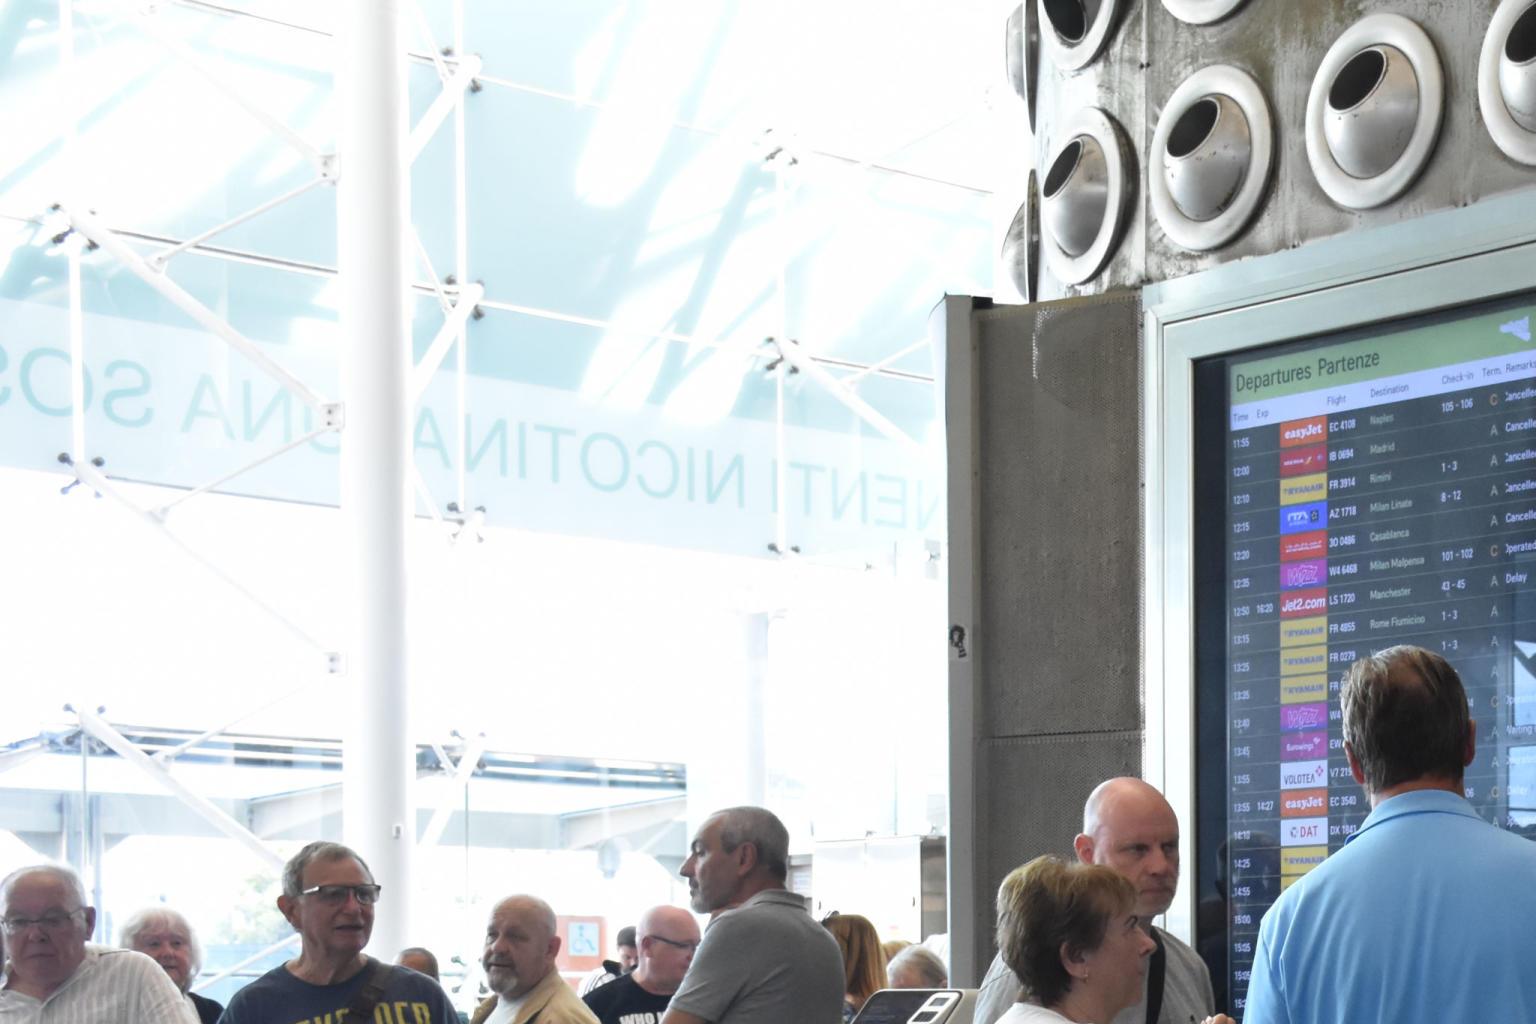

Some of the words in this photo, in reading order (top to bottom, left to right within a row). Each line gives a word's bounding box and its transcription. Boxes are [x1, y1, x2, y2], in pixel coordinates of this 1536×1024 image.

[1236, 365, 1312, 392] Departures
[1318, 352, 1380, 376] Partenze
[1233, 413, 1248, 422] Time
[1327, 395, 1346, 406] Flight
[1370, 383, 1409, 398] Destination
[1442, 372, 1474, 385] Check-in
[1233, 438, 1250, 448] 11:55
[1284, 424, 1323, 440] easyJet
[1370, 442, 1396, 454] Madrid
[1490, 424, 1498, 436] A
[1233, 494, 1250, 505] 12:10
[1329, 480, 1338, 490] FR
[1370, 472, 1392, 483] Rimini
[1233, 522, 1250, 533] 12:15
[1329, 508, 1340, 520] AZ
[1370, 528, 1410, 542] Casablanca
[1442, 552, 1454, 562] 101
[1461, 548, 1474, 560] 102
[1282, 598, 1326, 612] Jet2.com
[1370, 586, 1412, 600] Manchester
[1506, 572, 1528, 584] Delay
[1370, 618, 1390, 630] Rome
[1284, 774, 1316, 785] VOLOTEA
[1286, 796, 1324, 810] easyJet
[1330, 798, 1340, 806] EC
[1300, 826, 1318, 838] DAT
